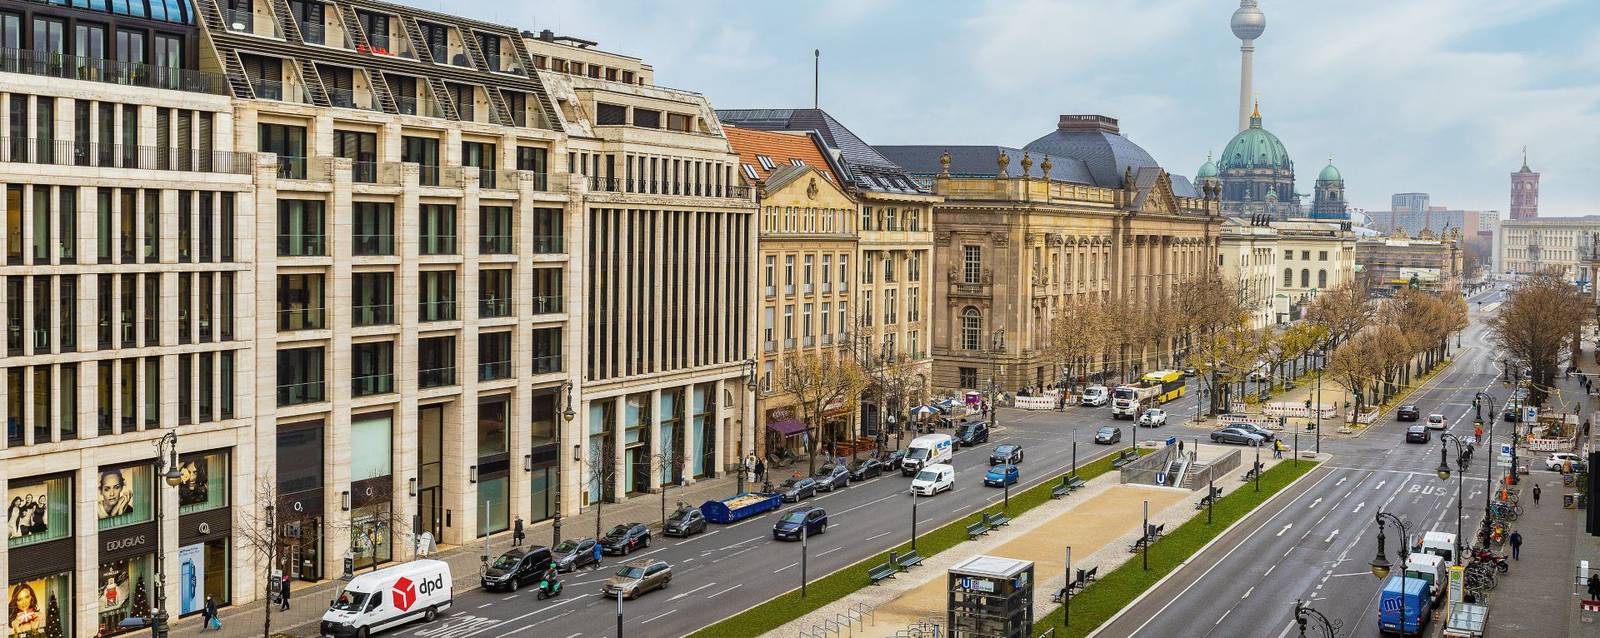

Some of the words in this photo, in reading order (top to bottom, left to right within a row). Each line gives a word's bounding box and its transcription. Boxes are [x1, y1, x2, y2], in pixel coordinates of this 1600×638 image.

[1157, 473, 1165, 484] U
[1408, 484, 1447, 496] BUS
[106, 535, 146, 551] DOUGLAS
[419, 573, 443, 596] dpd
[962, 579, 970, 588] U
